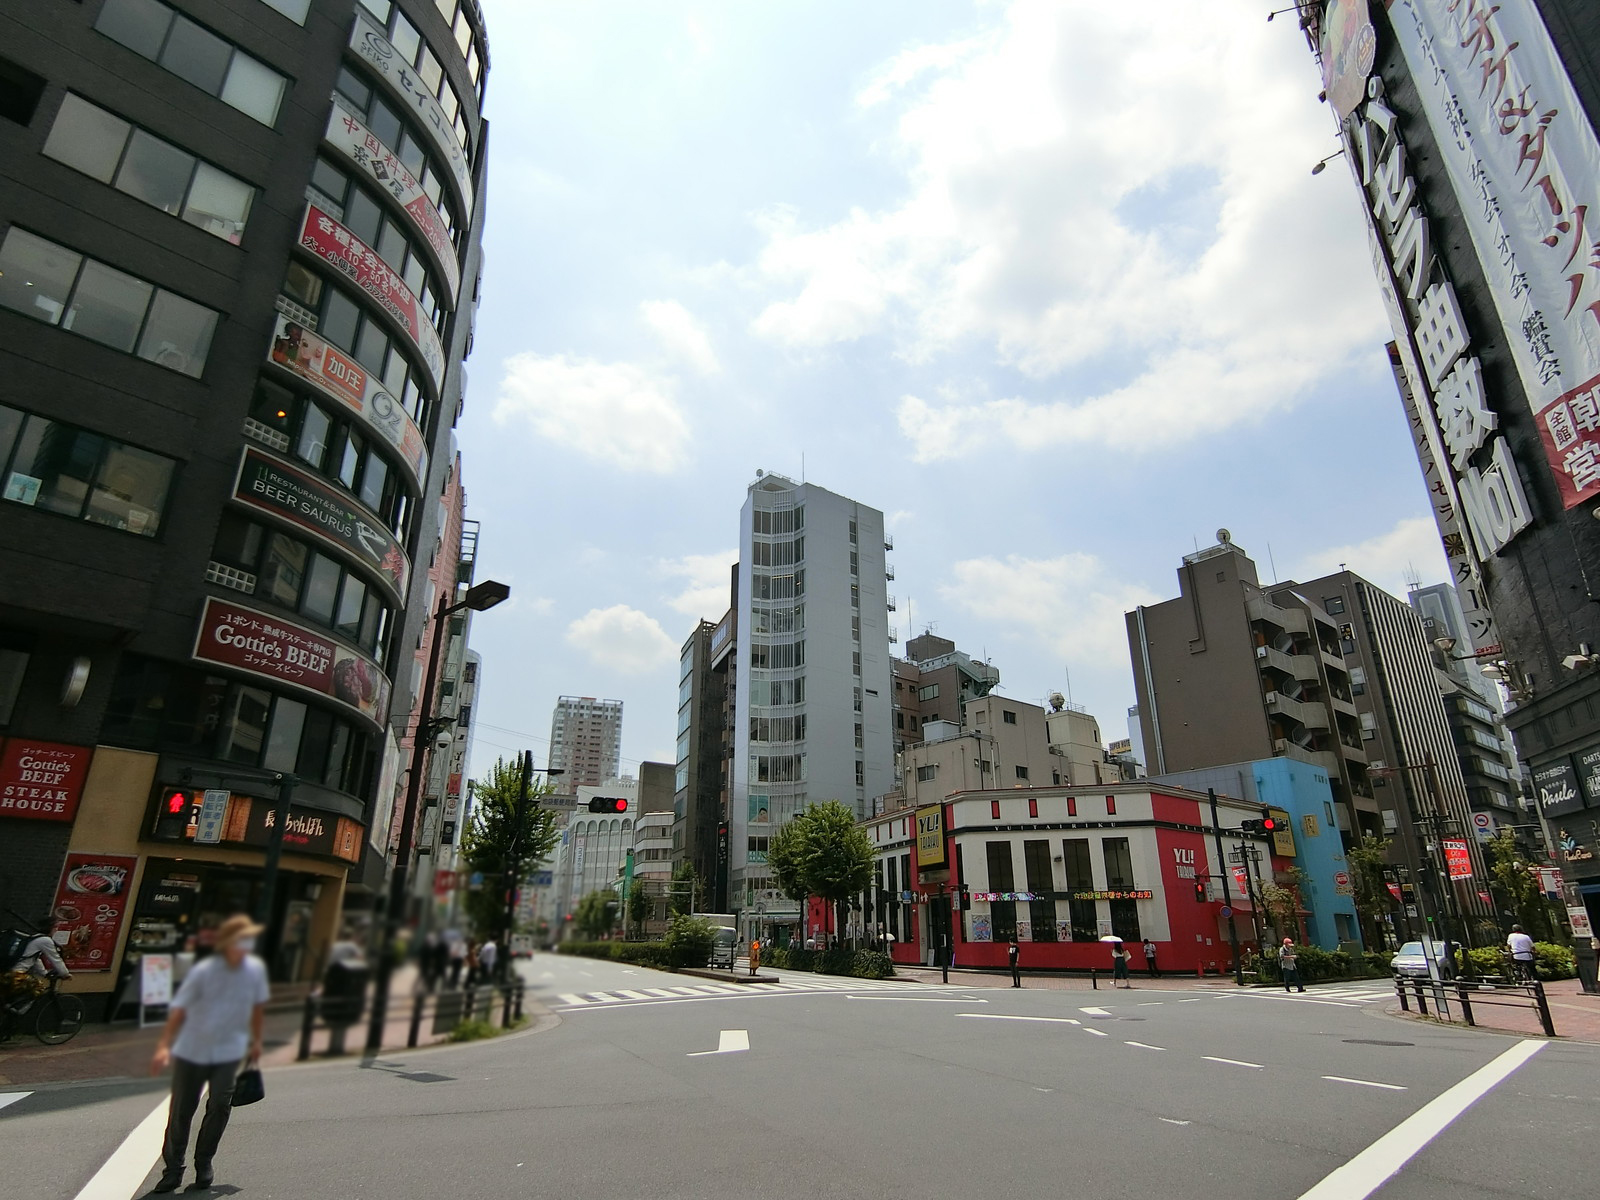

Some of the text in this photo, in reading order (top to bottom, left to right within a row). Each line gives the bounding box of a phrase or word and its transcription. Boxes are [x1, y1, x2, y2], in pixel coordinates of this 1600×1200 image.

[361, 41, 390, 72] SEIKO
[342, 116, 416, 196] 中国料理
[317, 216, 411, 305] 各種宴会大歓迎
[329, 356, 362, 392] 加圧
[1550, 410, 1573, 446] 全館
[253, 480, 353, 538] BEER SAURUS
[215, 624, 330, 675] Gottie's BEEF
[244, 653, 305, 678] ゴッチーズビーフ
[19, 756, 72, 773] Gottie's
[20, 770, 65, 785] BEEF
[0, 797, 65, 813] HOUSE
[4, 785, 69, 801] STEAK
[1541, 783, 1576, 810] Pasela
[264, 809, 325, 837] 長ちゃんぽん
[918, 813, 940, 835] YU!
[1173, 848, 1195, 864] YU!
